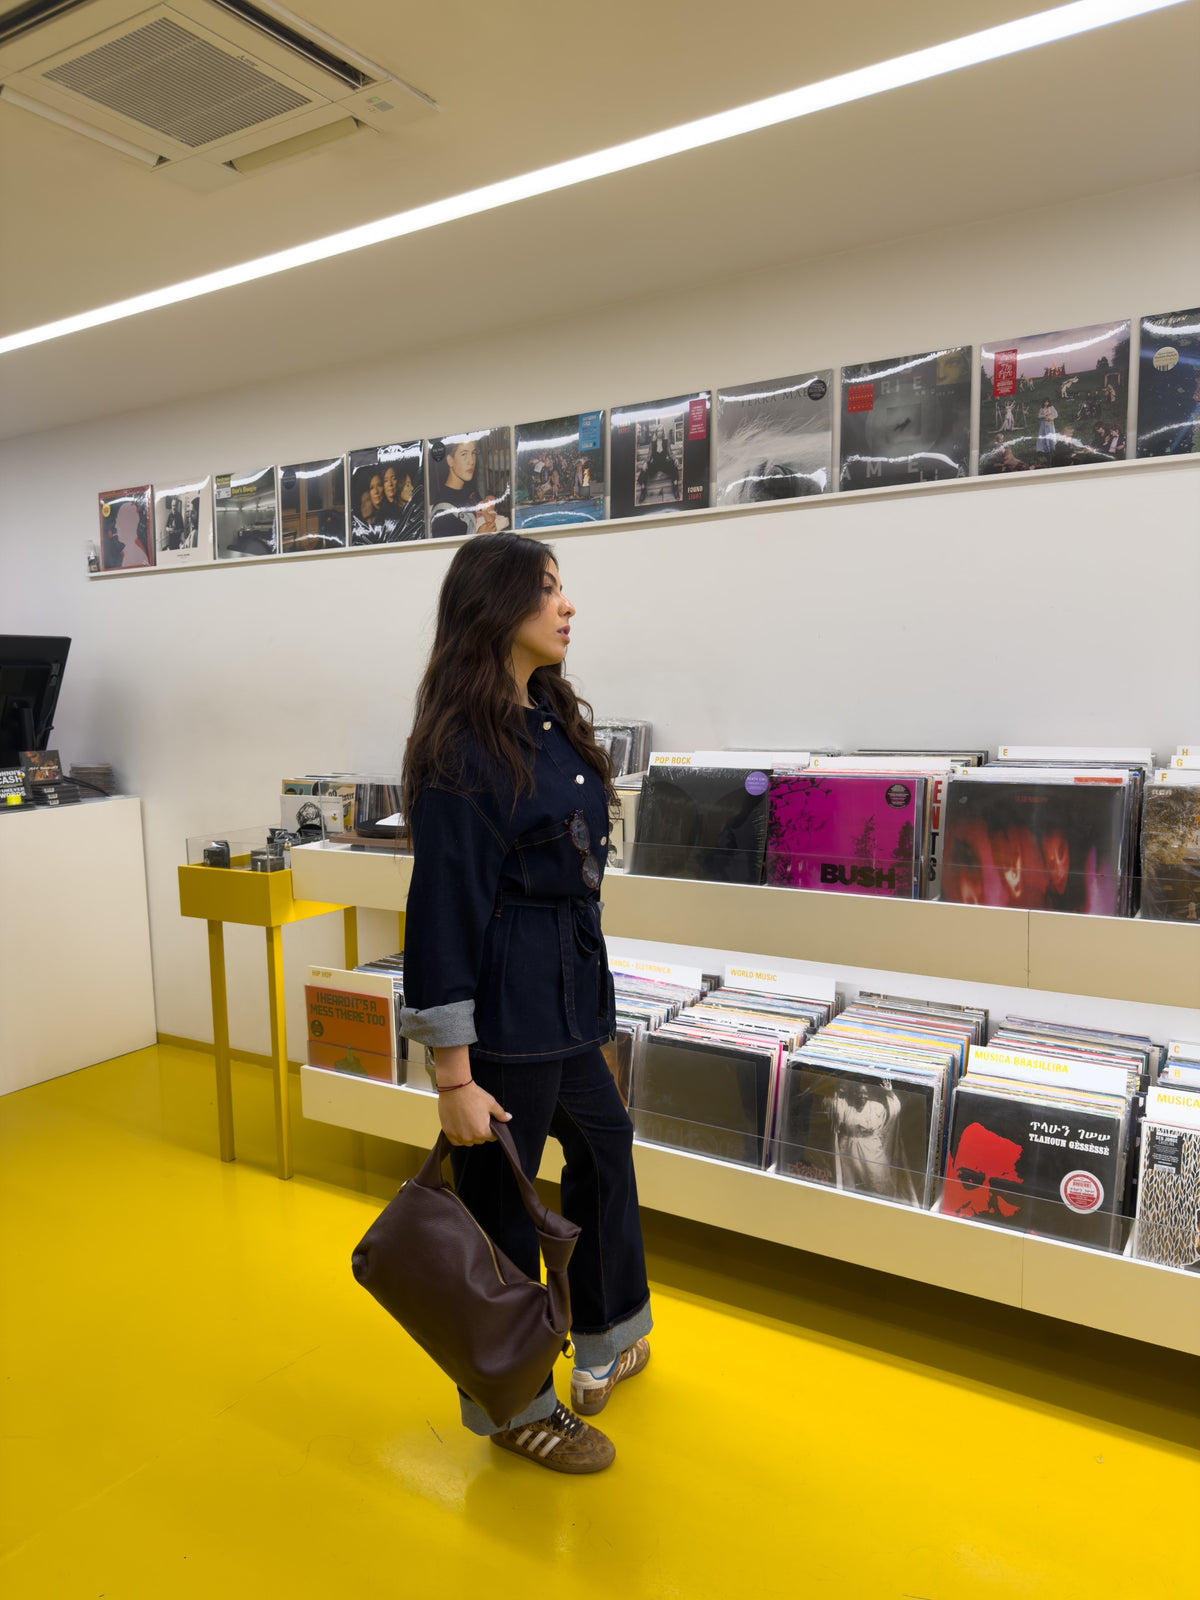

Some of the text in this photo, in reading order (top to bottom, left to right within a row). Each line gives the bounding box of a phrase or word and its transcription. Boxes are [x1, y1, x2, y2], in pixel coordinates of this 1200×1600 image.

[1002, 748, 1008, 756] E
[1182, 748, 1189, 756] H
[654, 755, 691, 765] POP ROCK
[813, 759, 819, 767] C
[1176, 758, 1183, 767] G
[1161, 772, 1168, 782] F
[820, 863, 896, 889] BUSH
[730, 969, 777, 982] WORLD MUSIC
[320, 993, 350, 1007] HEARD
[370, 1000, 376, 1012] A
[310, 1004, 385, 1026] MESS THERE TOO
[1173, 1045, 1180, 1054] C
[1013, 1056, 1069, 1074] BRASILEIRA
[1029, 1133, 1067, 1147] TLAHOUN
